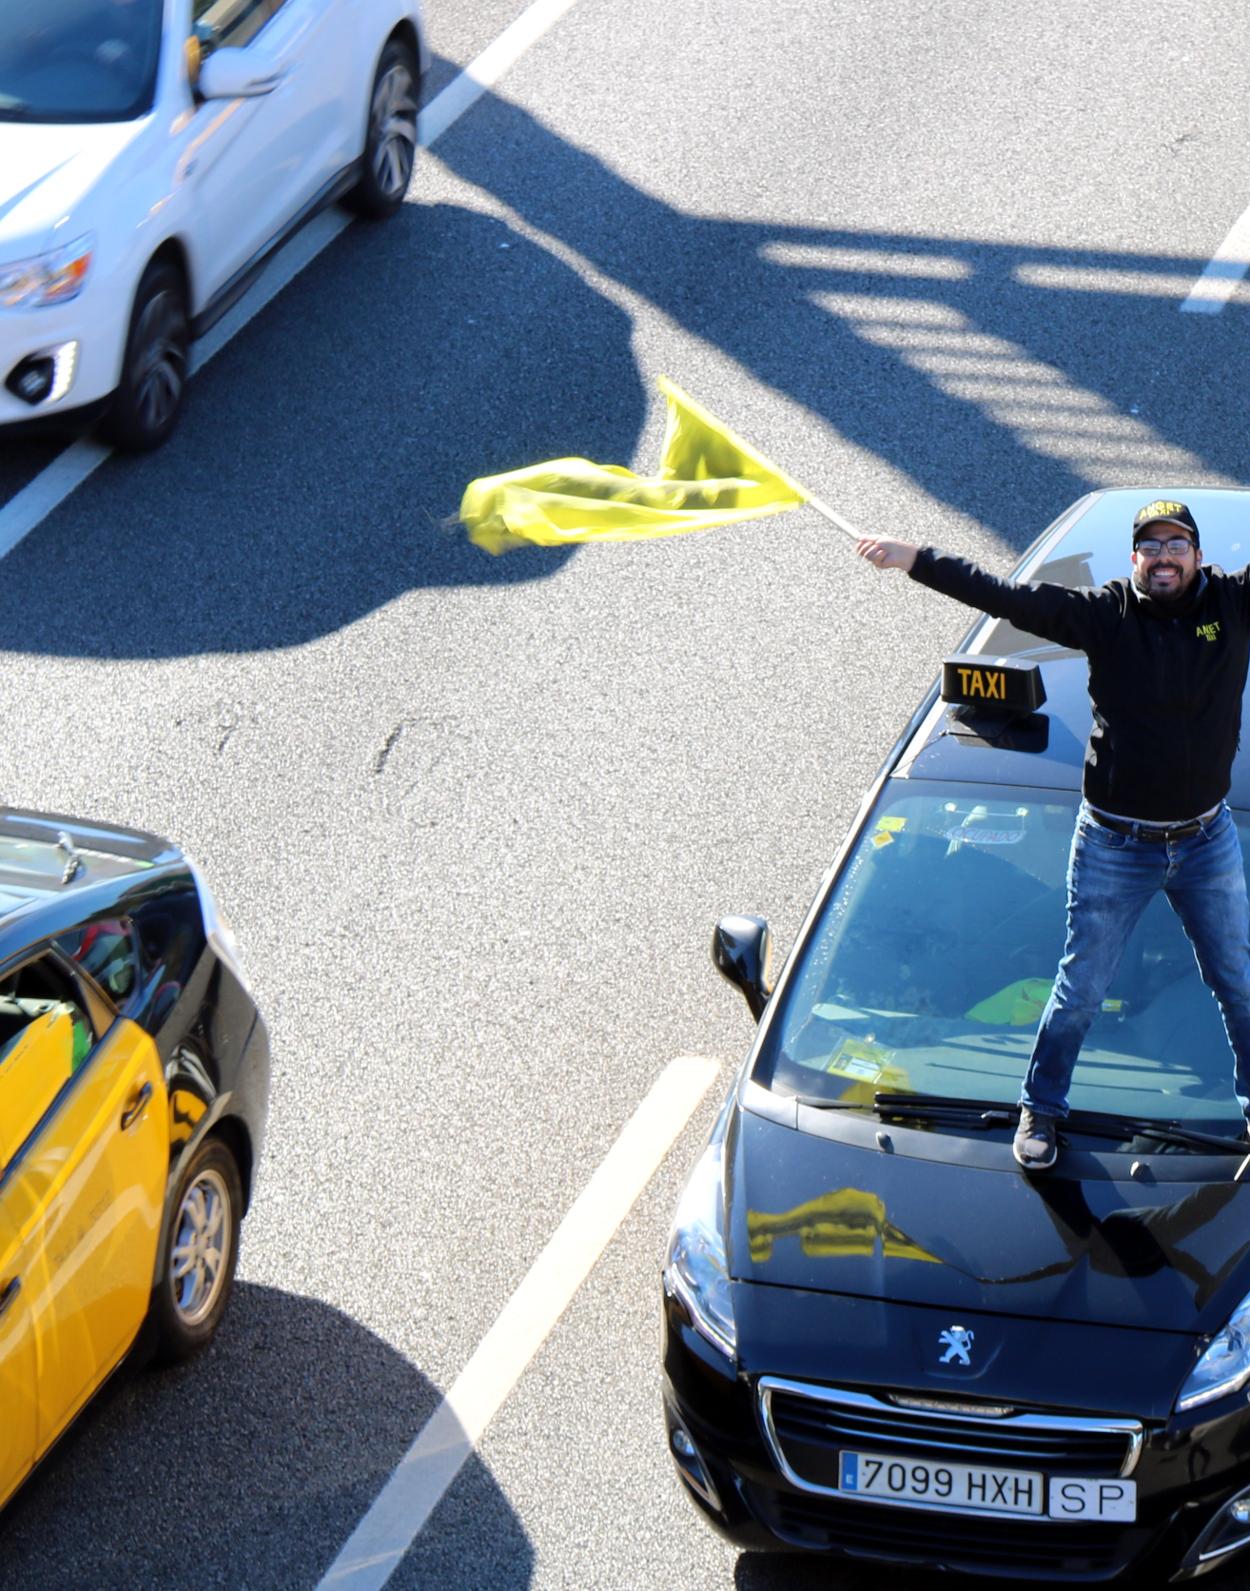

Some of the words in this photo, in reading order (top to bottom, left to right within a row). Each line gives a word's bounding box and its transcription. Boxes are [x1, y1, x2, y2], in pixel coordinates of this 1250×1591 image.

[957, 668, 1006, 700] TAXI
[863, 1459, 953, 1498] 7099
[967, 1471, 1034, 1508] HXH
[1060, 1483, 1125, 1515] SP
